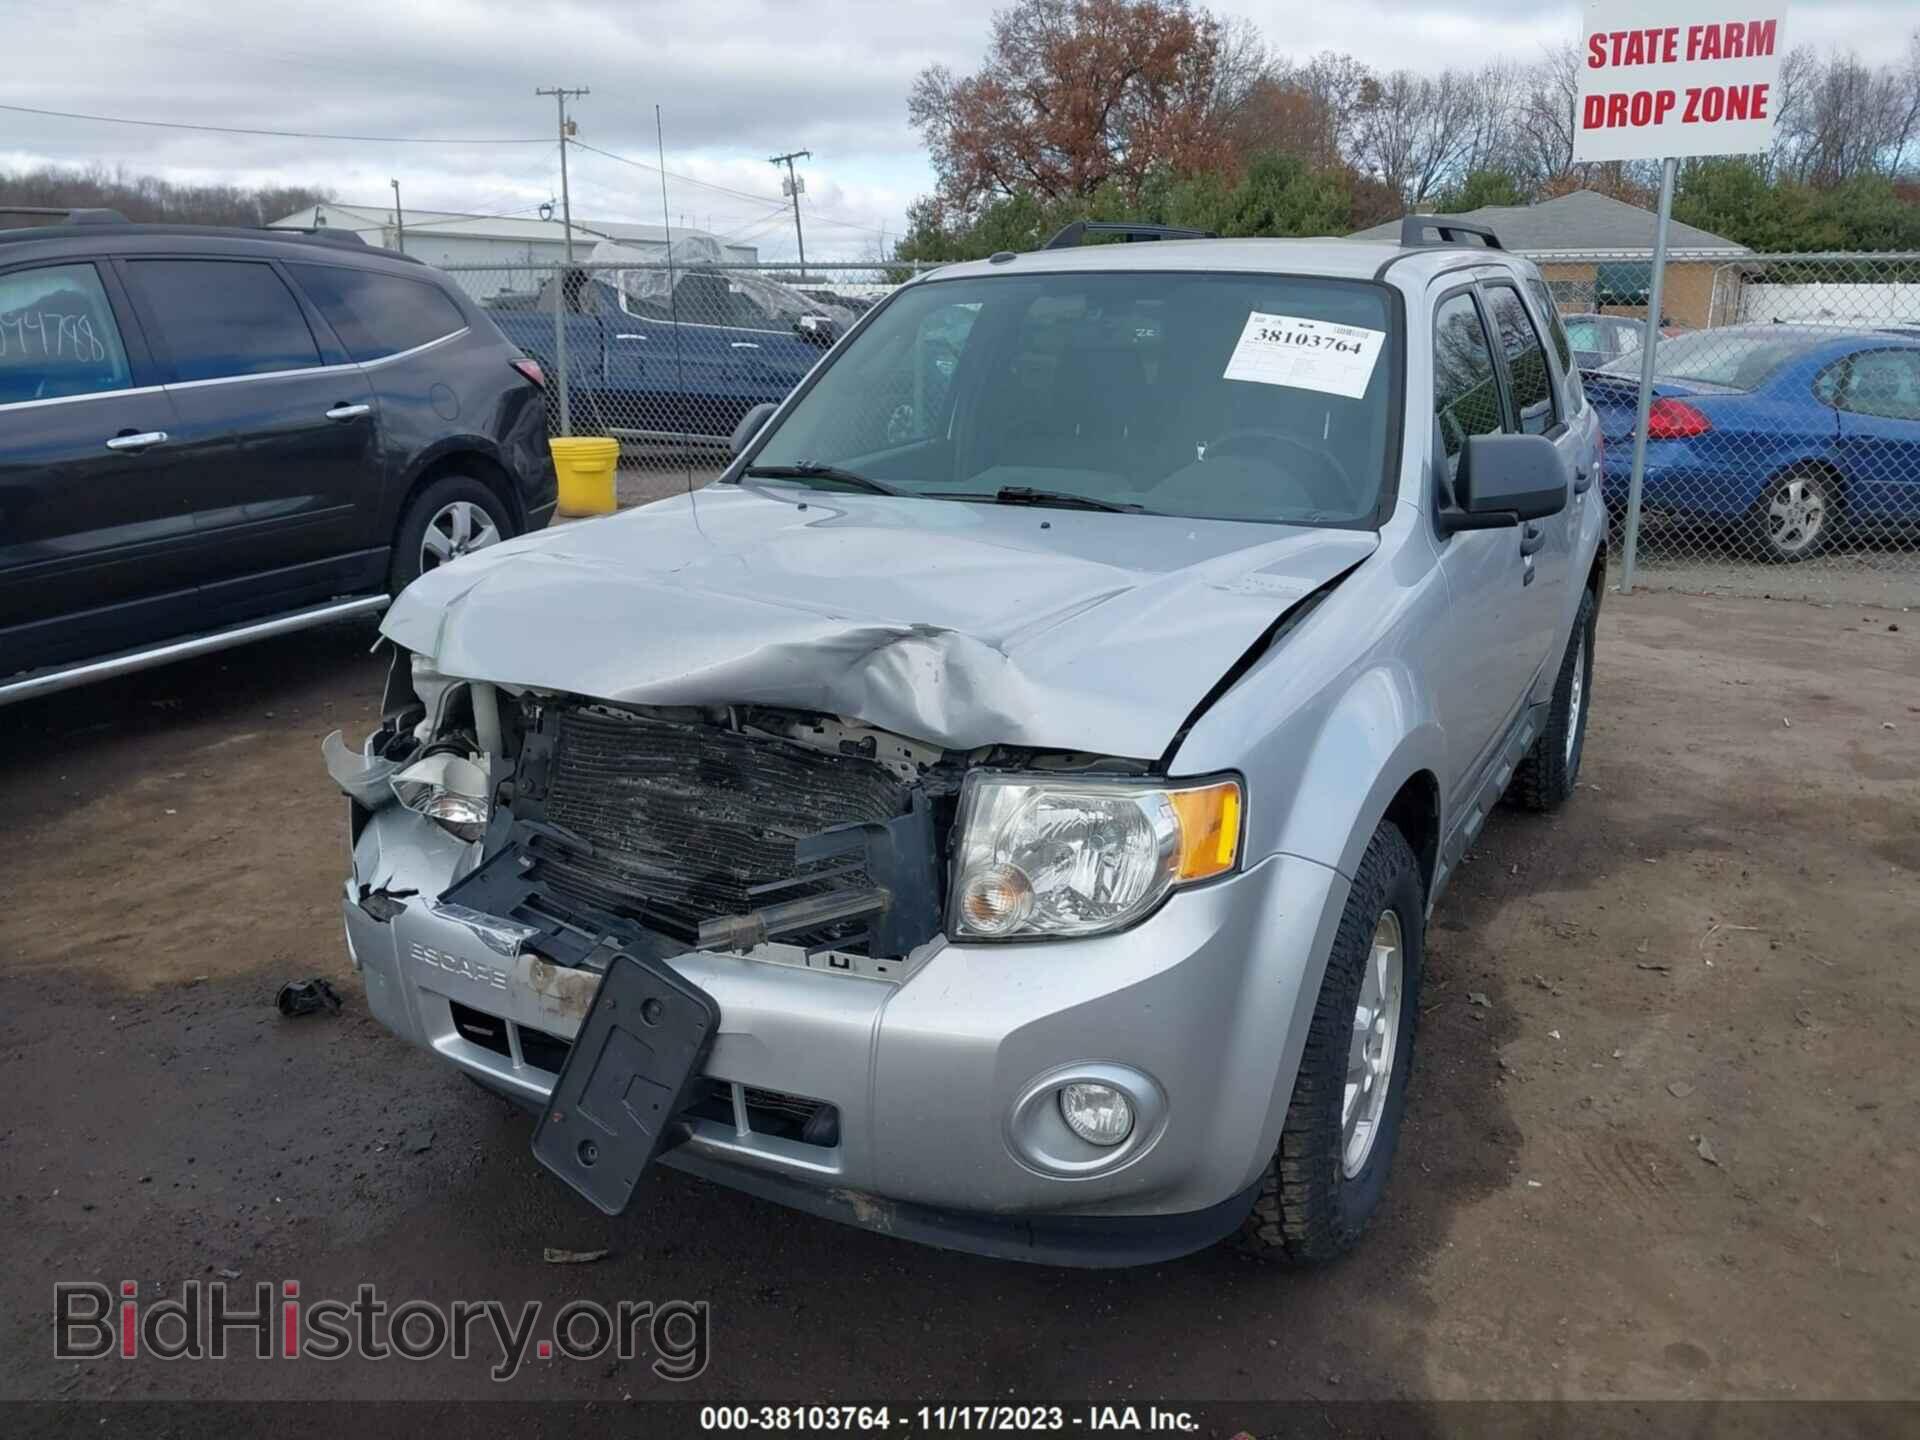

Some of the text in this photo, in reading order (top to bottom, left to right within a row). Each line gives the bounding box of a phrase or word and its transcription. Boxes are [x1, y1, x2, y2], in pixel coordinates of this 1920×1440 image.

[1588, 19, 1777, 68] STATE FARM
[1583, 84, 1769, 129] DROP ZONE
[1254, 328, 1362, 355] 38103764
[409, 942, 507, 990] ESCAPE
